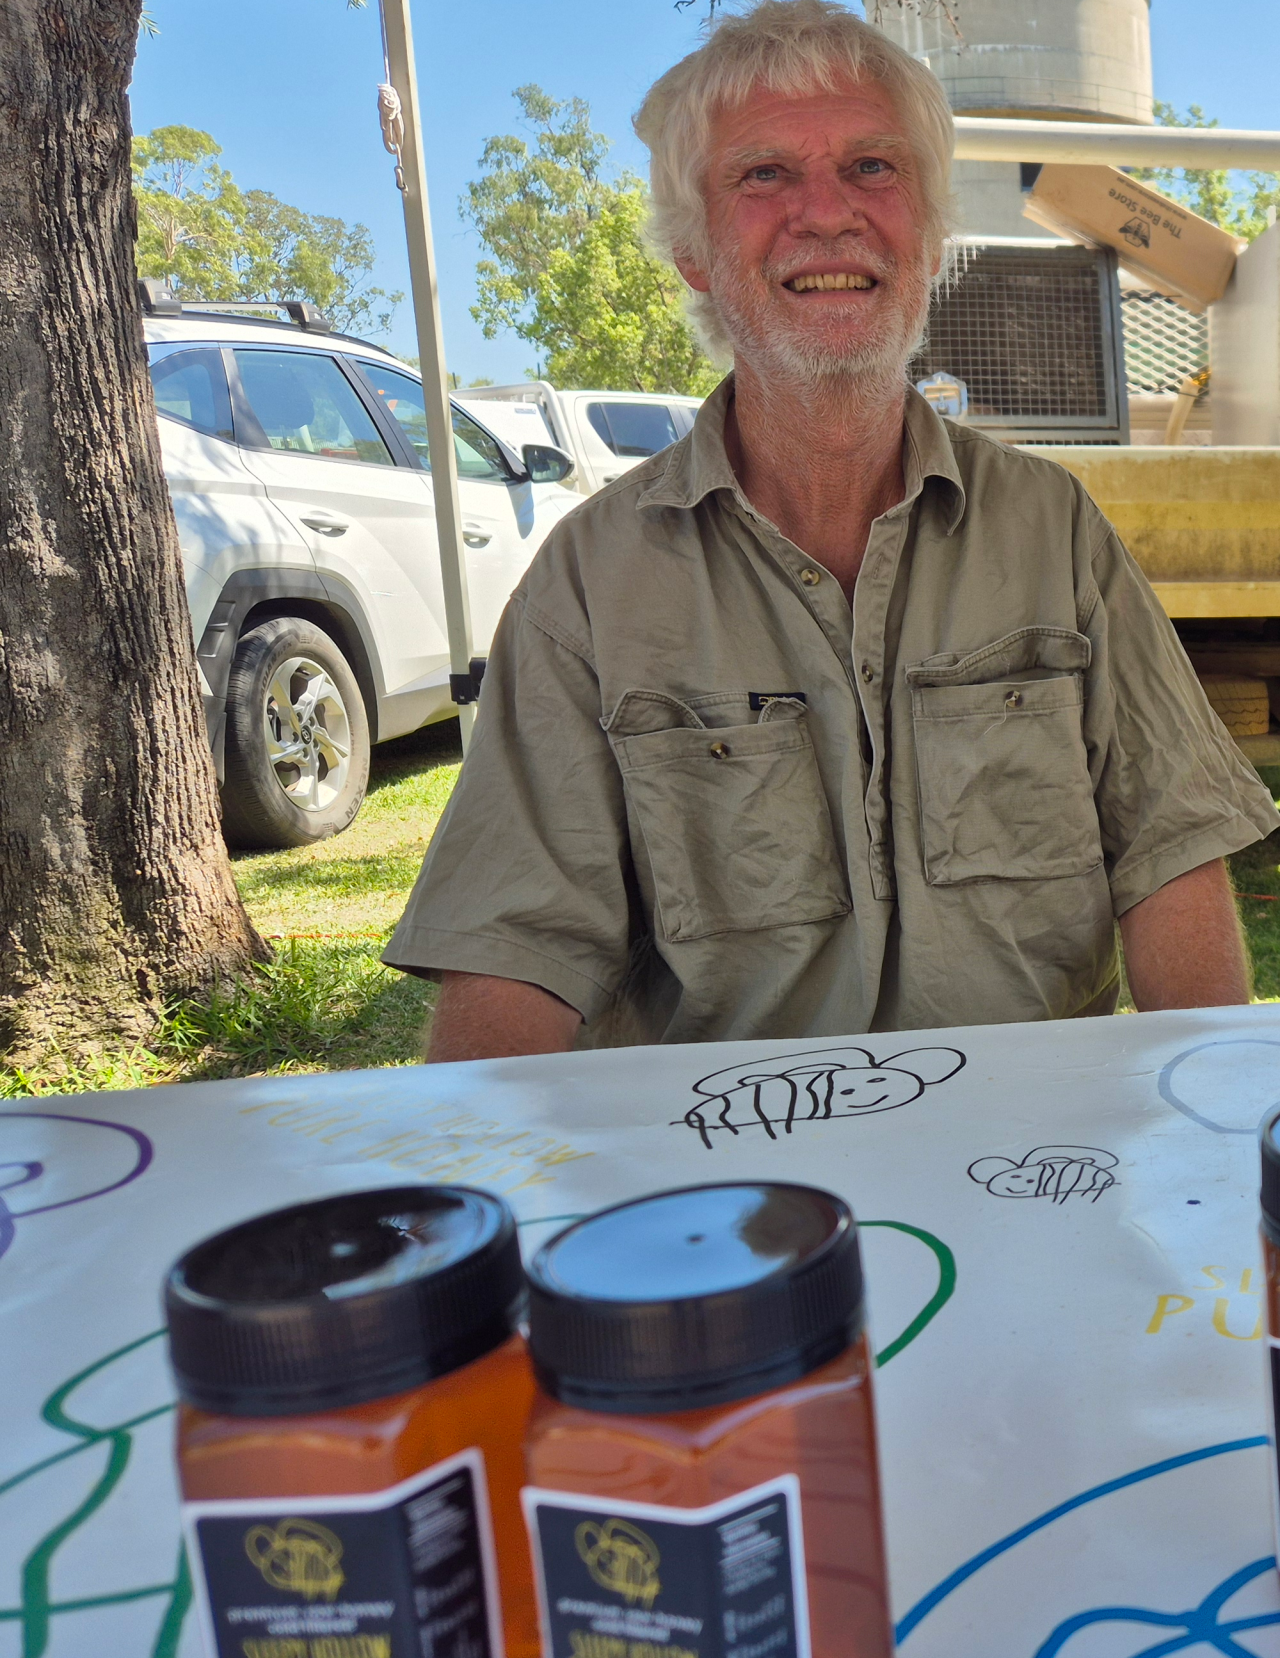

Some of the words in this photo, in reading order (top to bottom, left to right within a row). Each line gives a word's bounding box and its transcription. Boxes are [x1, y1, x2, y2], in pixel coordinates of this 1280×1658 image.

[1108, 188, 1139, 212] Store
[1140, 207, 1161, 226] Bee
[1162, 220, 1182, 239] The
[345, 757, 368, 819] NEXEN
[239, 1093, 390, 1146] PURE
[357, 1129, 559, 1197] HONEY
[431, 1112, 597, 1167] HOLLOW
[1145, 1294, 1263, 1341] PU
